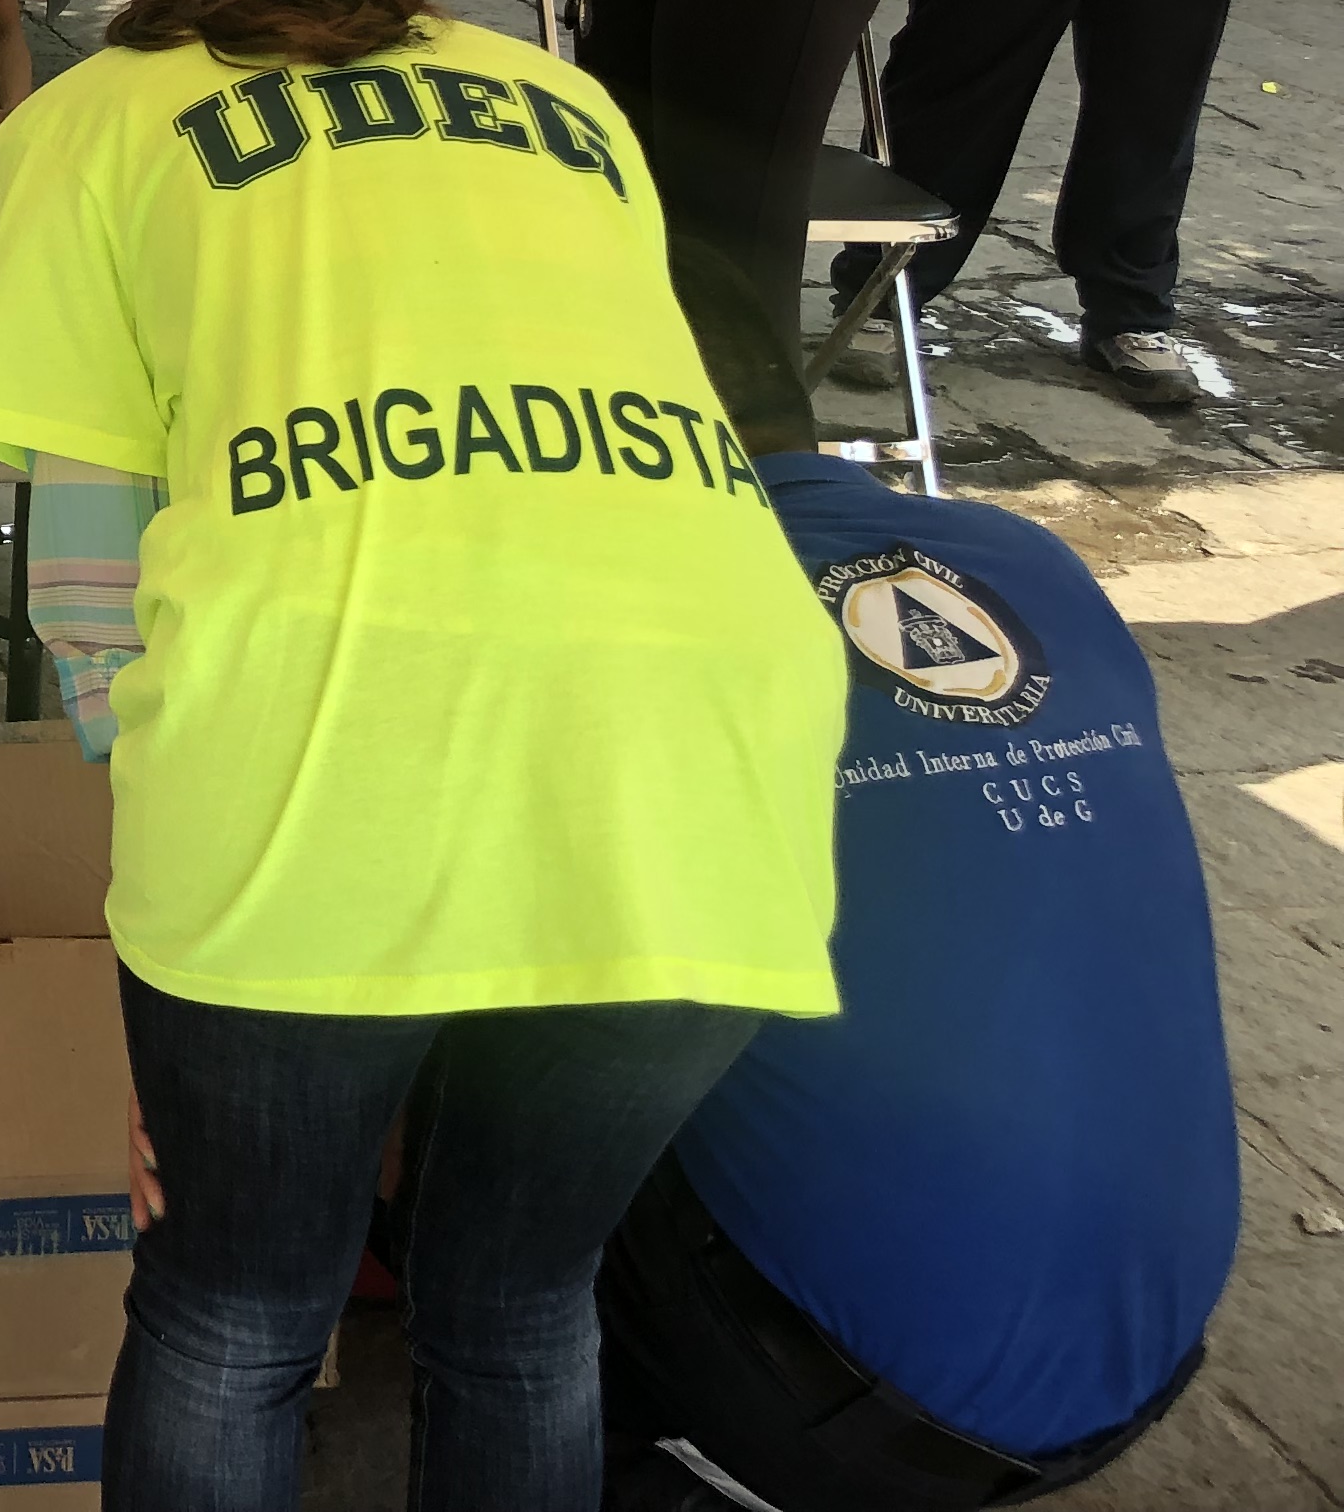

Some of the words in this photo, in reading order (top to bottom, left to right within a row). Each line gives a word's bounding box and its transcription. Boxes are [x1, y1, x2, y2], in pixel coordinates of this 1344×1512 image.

[173, 62, 629, 205] UDEG
[228, 383, 771, 517] BRIGADISTA
[913, 550, 964, 589] CIVIL
[916, 749, 998, 776] Interna
[1006, 741, 1028, 767] de
[1029, 729, 1112, 762] Protección
[998, 808, 1023, 832] U
[1038, 804, 1066, 827] de
[1074, 799, 1094, 822] G
